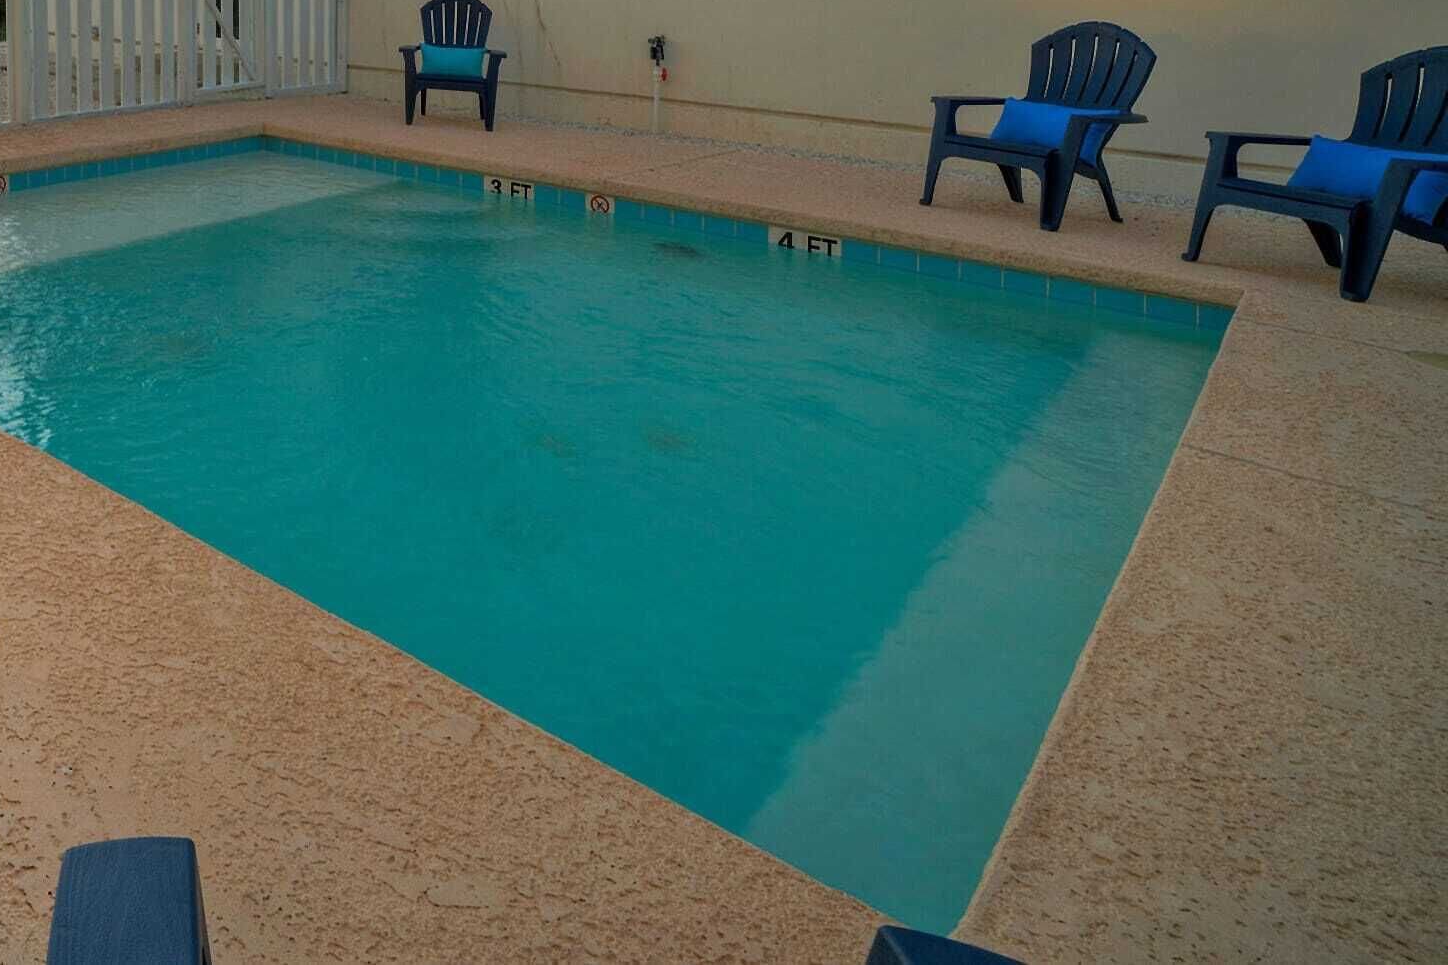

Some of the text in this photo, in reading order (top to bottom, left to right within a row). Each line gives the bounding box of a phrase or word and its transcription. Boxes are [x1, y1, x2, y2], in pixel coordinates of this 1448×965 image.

[490, 179, 532, 200] 3 FT
[778, 231, 838, 258] 4 FT
